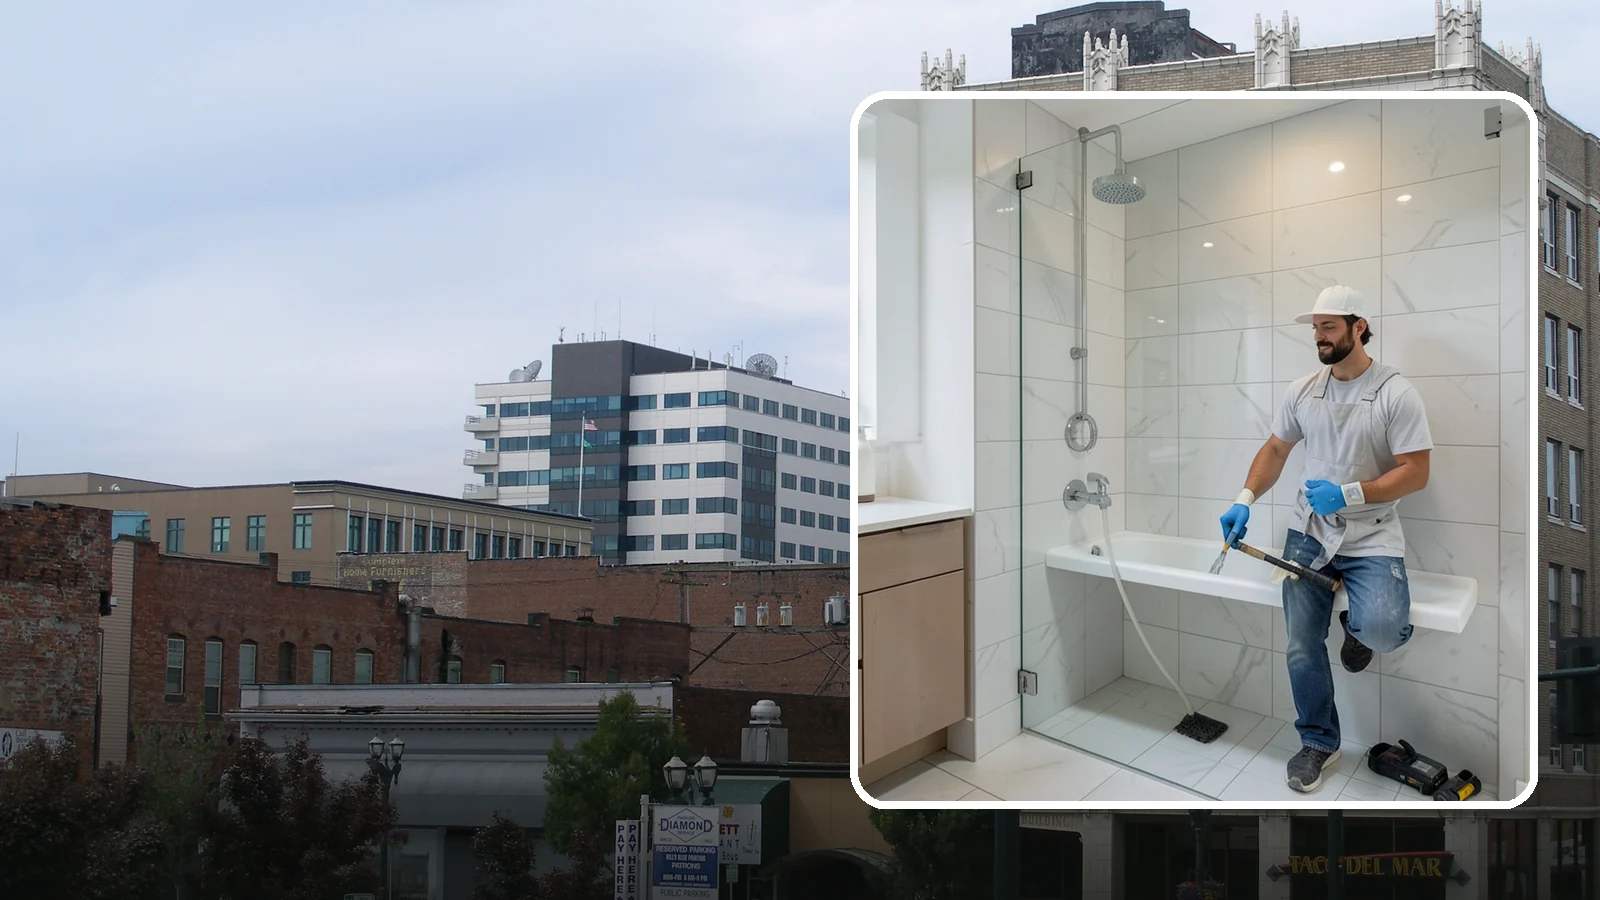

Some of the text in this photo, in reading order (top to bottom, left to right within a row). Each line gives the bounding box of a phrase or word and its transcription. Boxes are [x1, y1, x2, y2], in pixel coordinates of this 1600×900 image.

[343, 566, 427, 577] Home Furnishers
[660, 818, 713, 832] DIAMOND
[1021, 815, 1069, 828] BUILDING
[655, 845, 716, 854] RESERVED PARKING
[616, 825, 625, 893] PAY HERE
[671, 862, 701, 870] PATRONS
[1289, 855, 1442, 877] TAC DEL MAR
[628, 856, 636, 893] HERE
[660, 888, 710, 898] PUBLIC PARKING
